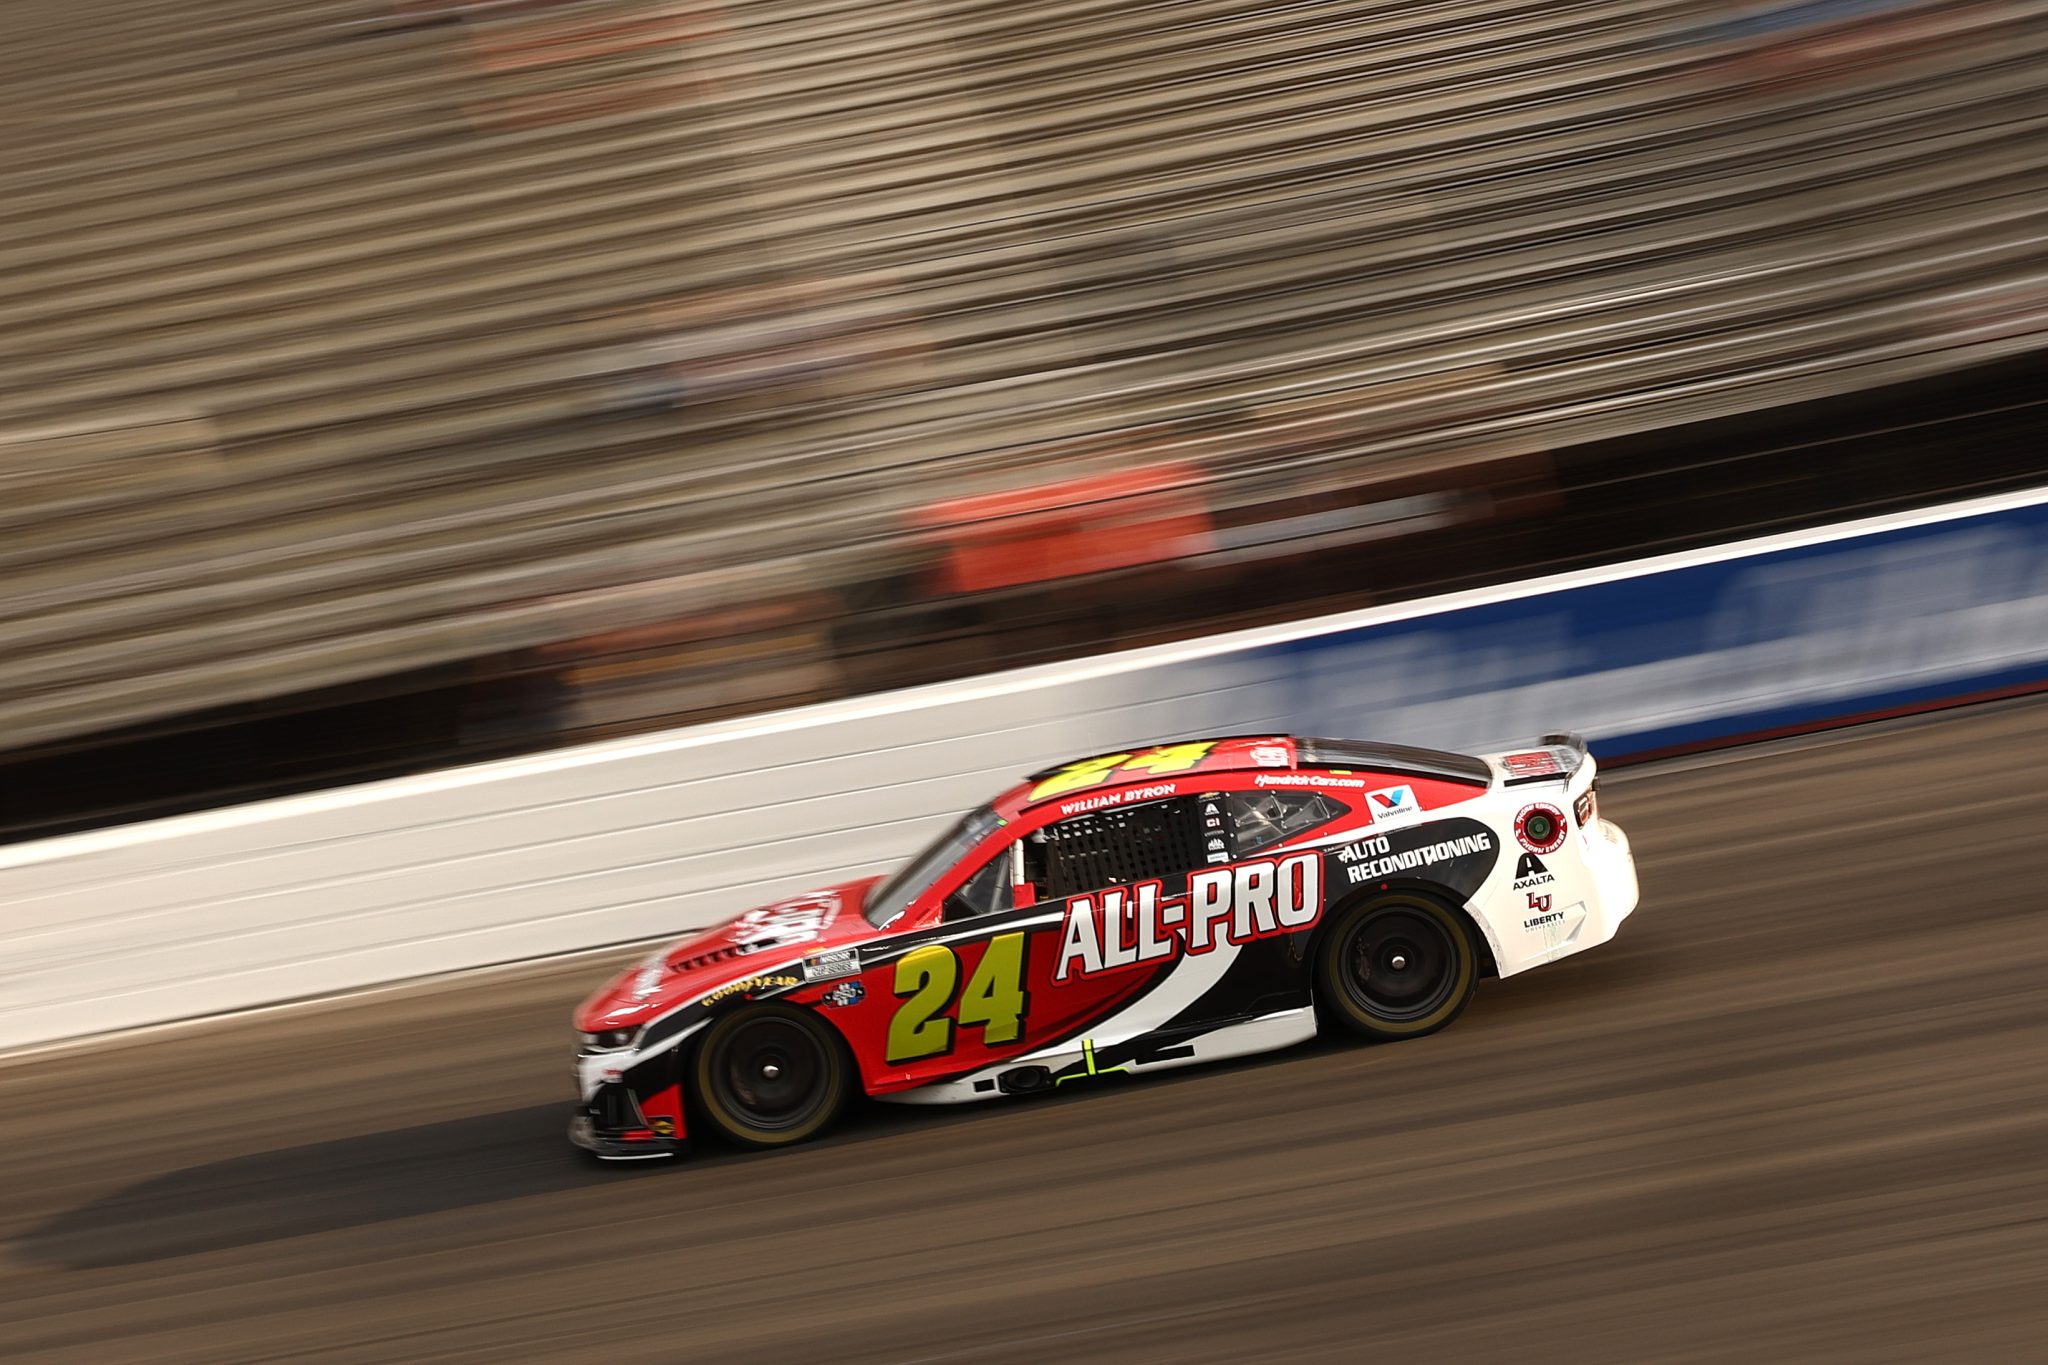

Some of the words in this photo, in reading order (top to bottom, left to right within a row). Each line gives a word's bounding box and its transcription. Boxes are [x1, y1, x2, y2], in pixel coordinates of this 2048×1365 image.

[1027, 741, 1220, 802] 24
[1060, 795, 1121, 815] WILLIAM
[1125, 784, 1177, 801] BYRON
[1377, 806, 1413, 819] Valvoline
[1338, 836, 1391, 864] AUTO
[1545, 829, 1566, 853] ENERGY
[1347, 832, 1492, 884] RECONDITIONING
[1513, 874, 1555, 891] AXALTA
[1053, 849, 1323, 983] ALL-PRO
[1526, 892, 1552, 912] LU
[1523, 911, 1565, 928] LIBERTY
[886, 931, 1027, 1062] 24
